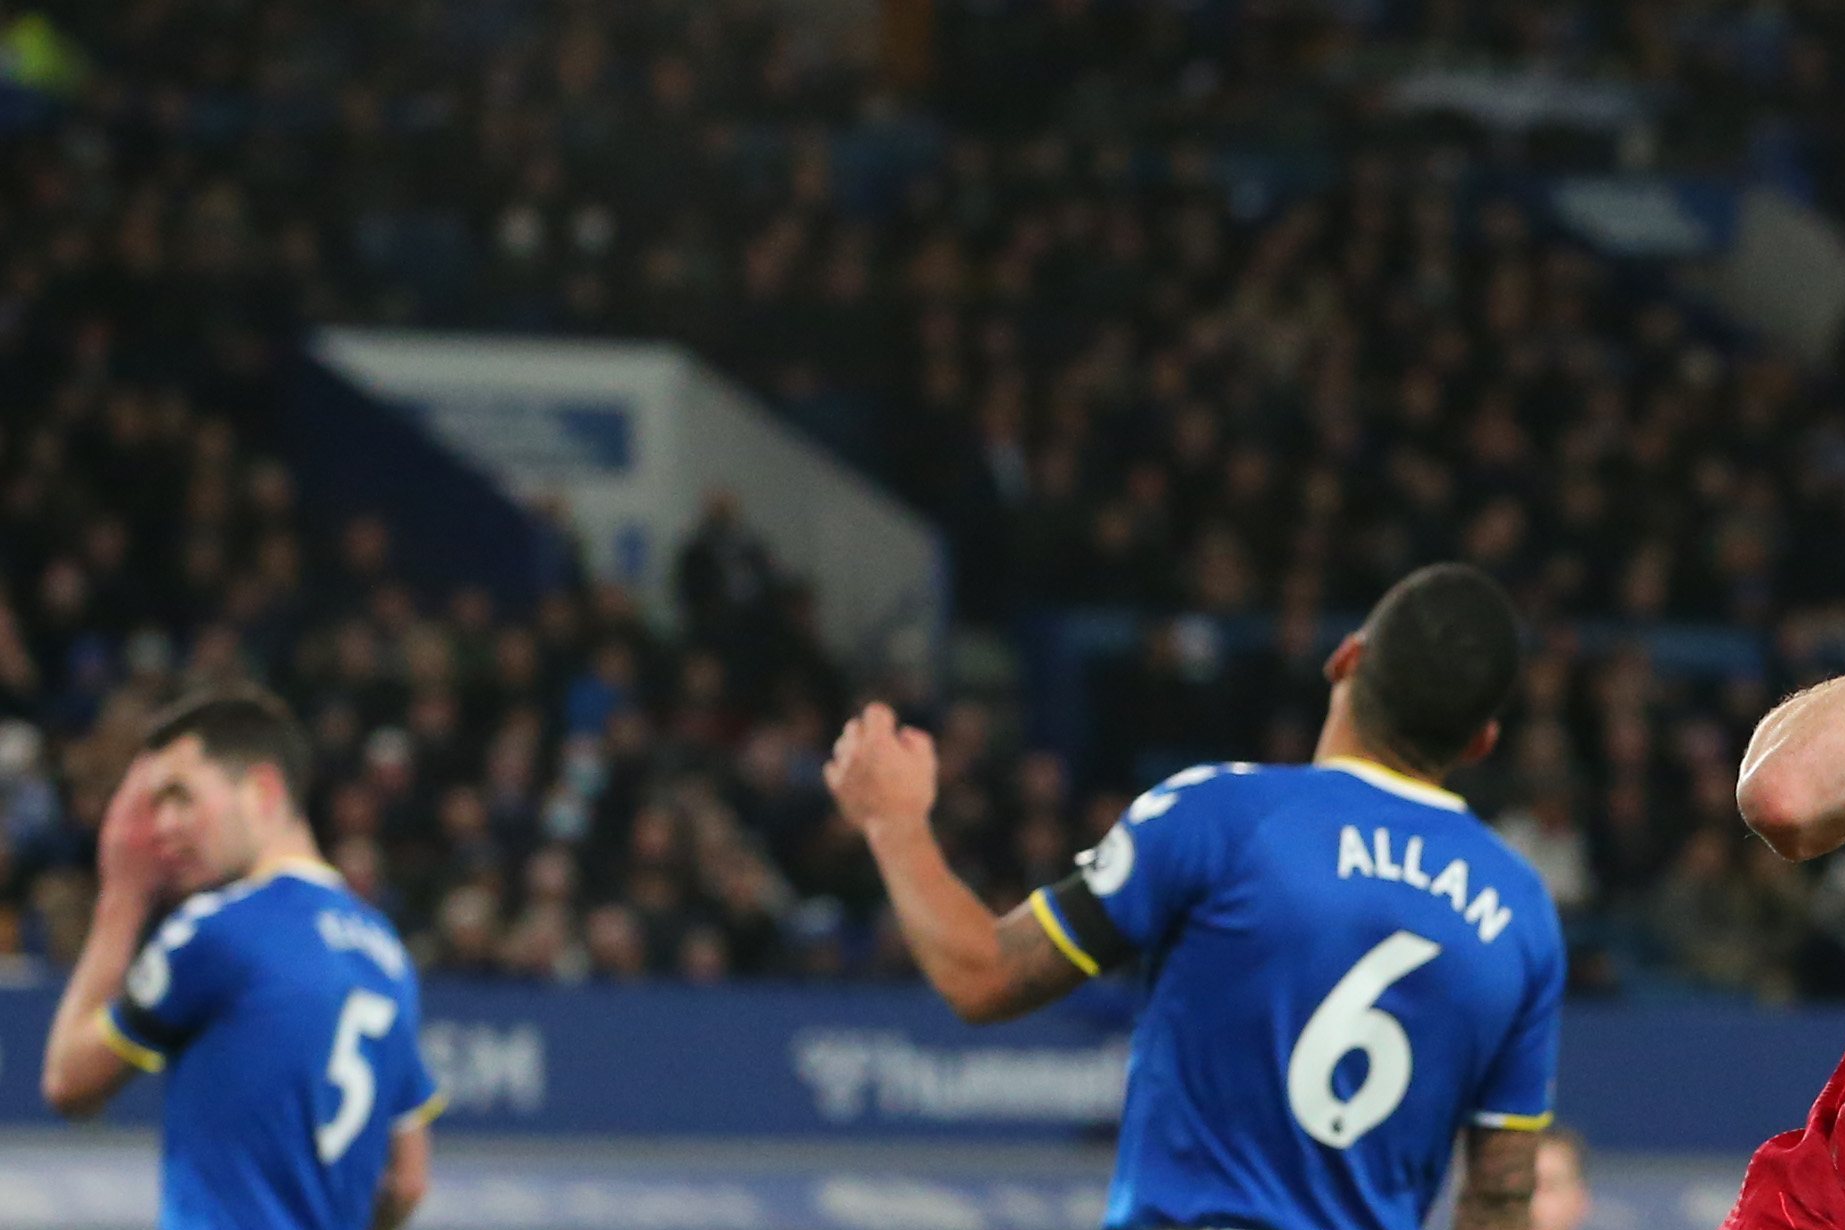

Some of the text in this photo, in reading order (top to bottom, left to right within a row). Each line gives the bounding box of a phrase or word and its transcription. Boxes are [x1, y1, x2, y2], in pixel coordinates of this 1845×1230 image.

[1337, 825, 1513, 944] ALLAN
[317, 988, 398, 1165] 5
[1288, 931, 1441, 1149] 6
